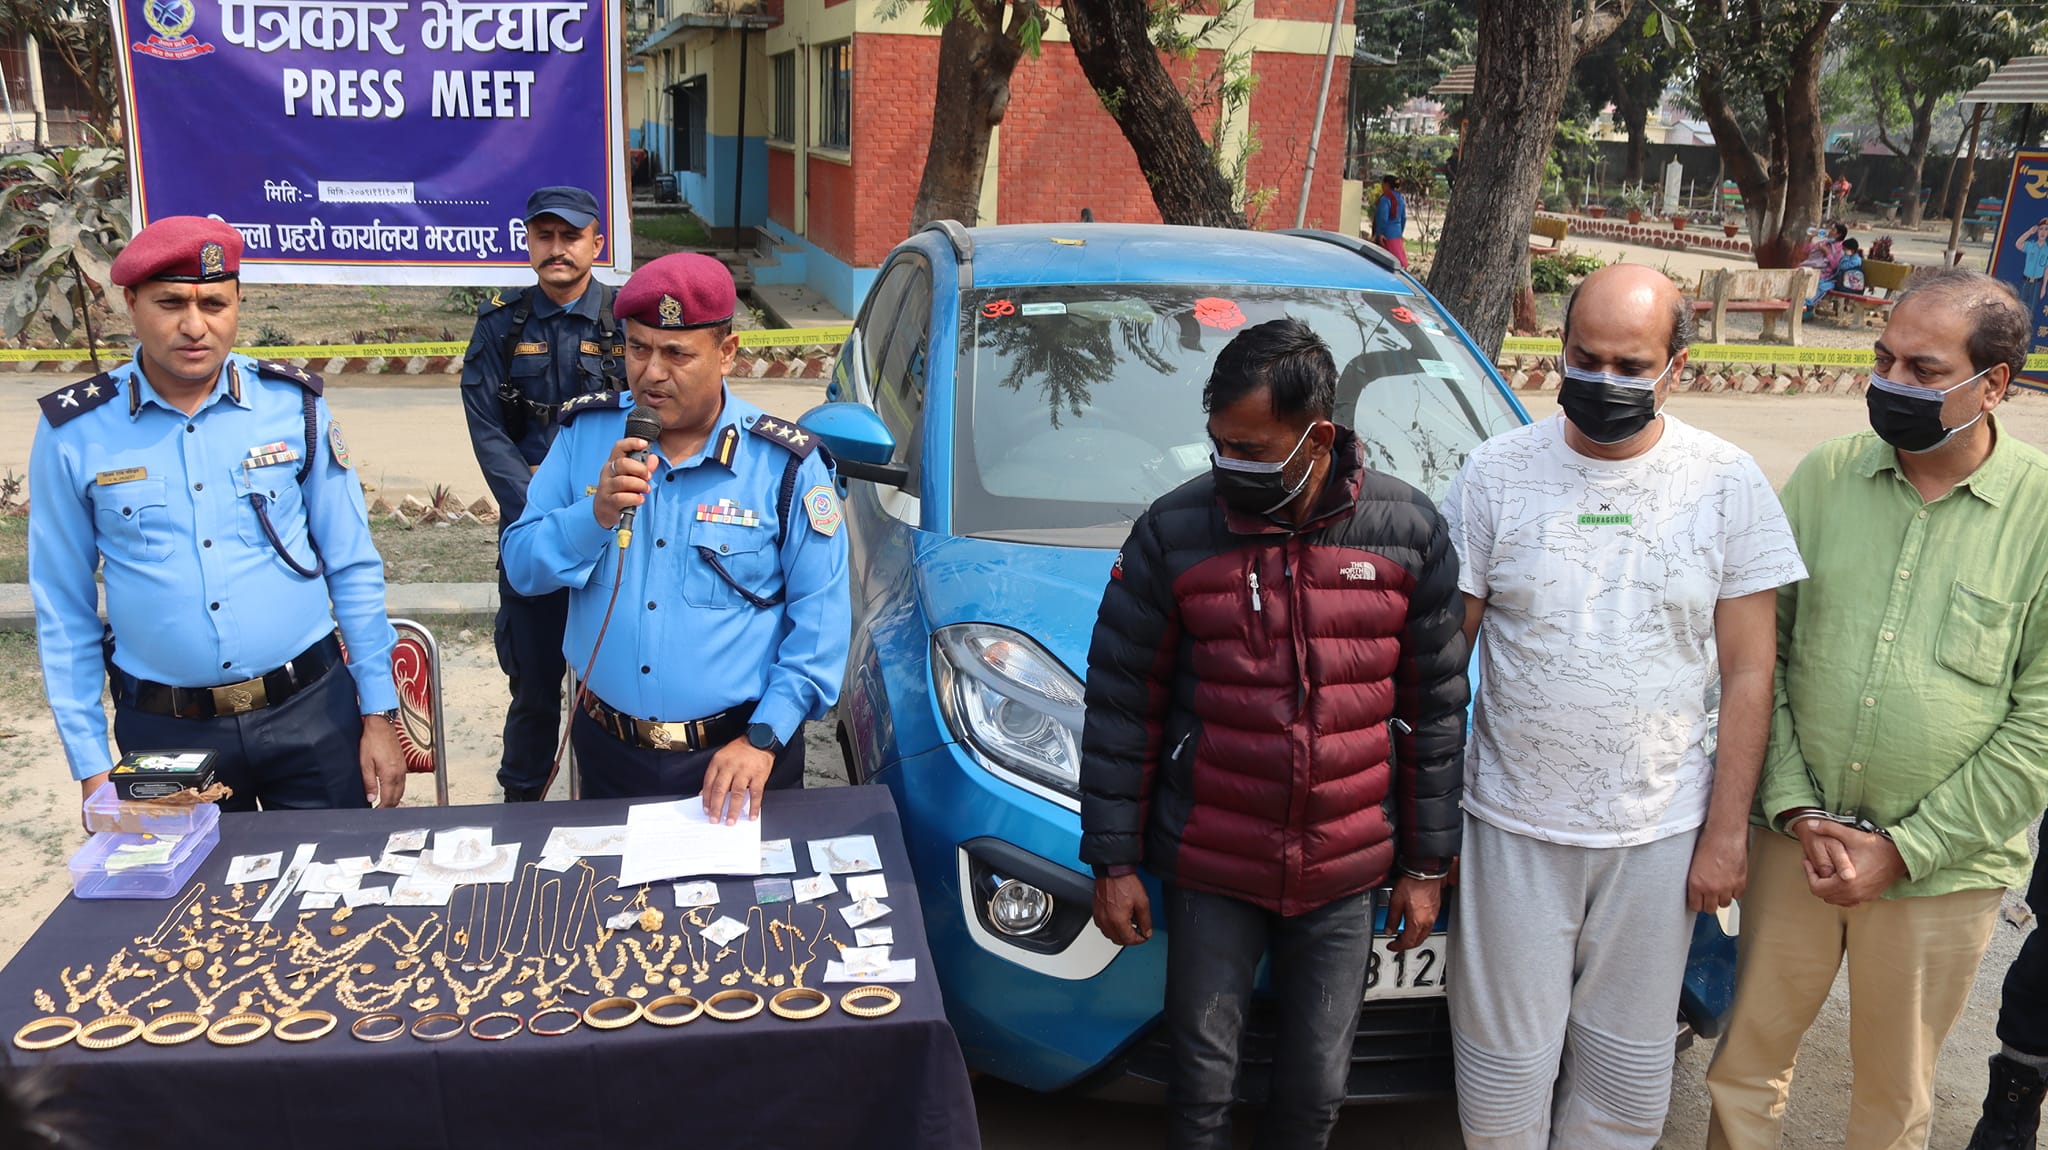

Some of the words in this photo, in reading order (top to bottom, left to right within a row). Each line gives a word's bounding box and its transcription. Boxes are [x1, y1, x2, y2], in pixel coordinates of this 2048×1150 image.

[218, 0, 408, 55] पत्रकार
[283, 68, 406, 118] PRESS
[431, 70, 535, 118] MEET
[276, 216, 326, 252] प्रहरी
[331, 219, 419, 252] कार्यालय
[1581, 516, 1629, 524] COURAGEOUS
[1340, 567, 1363, 575] NORTH
